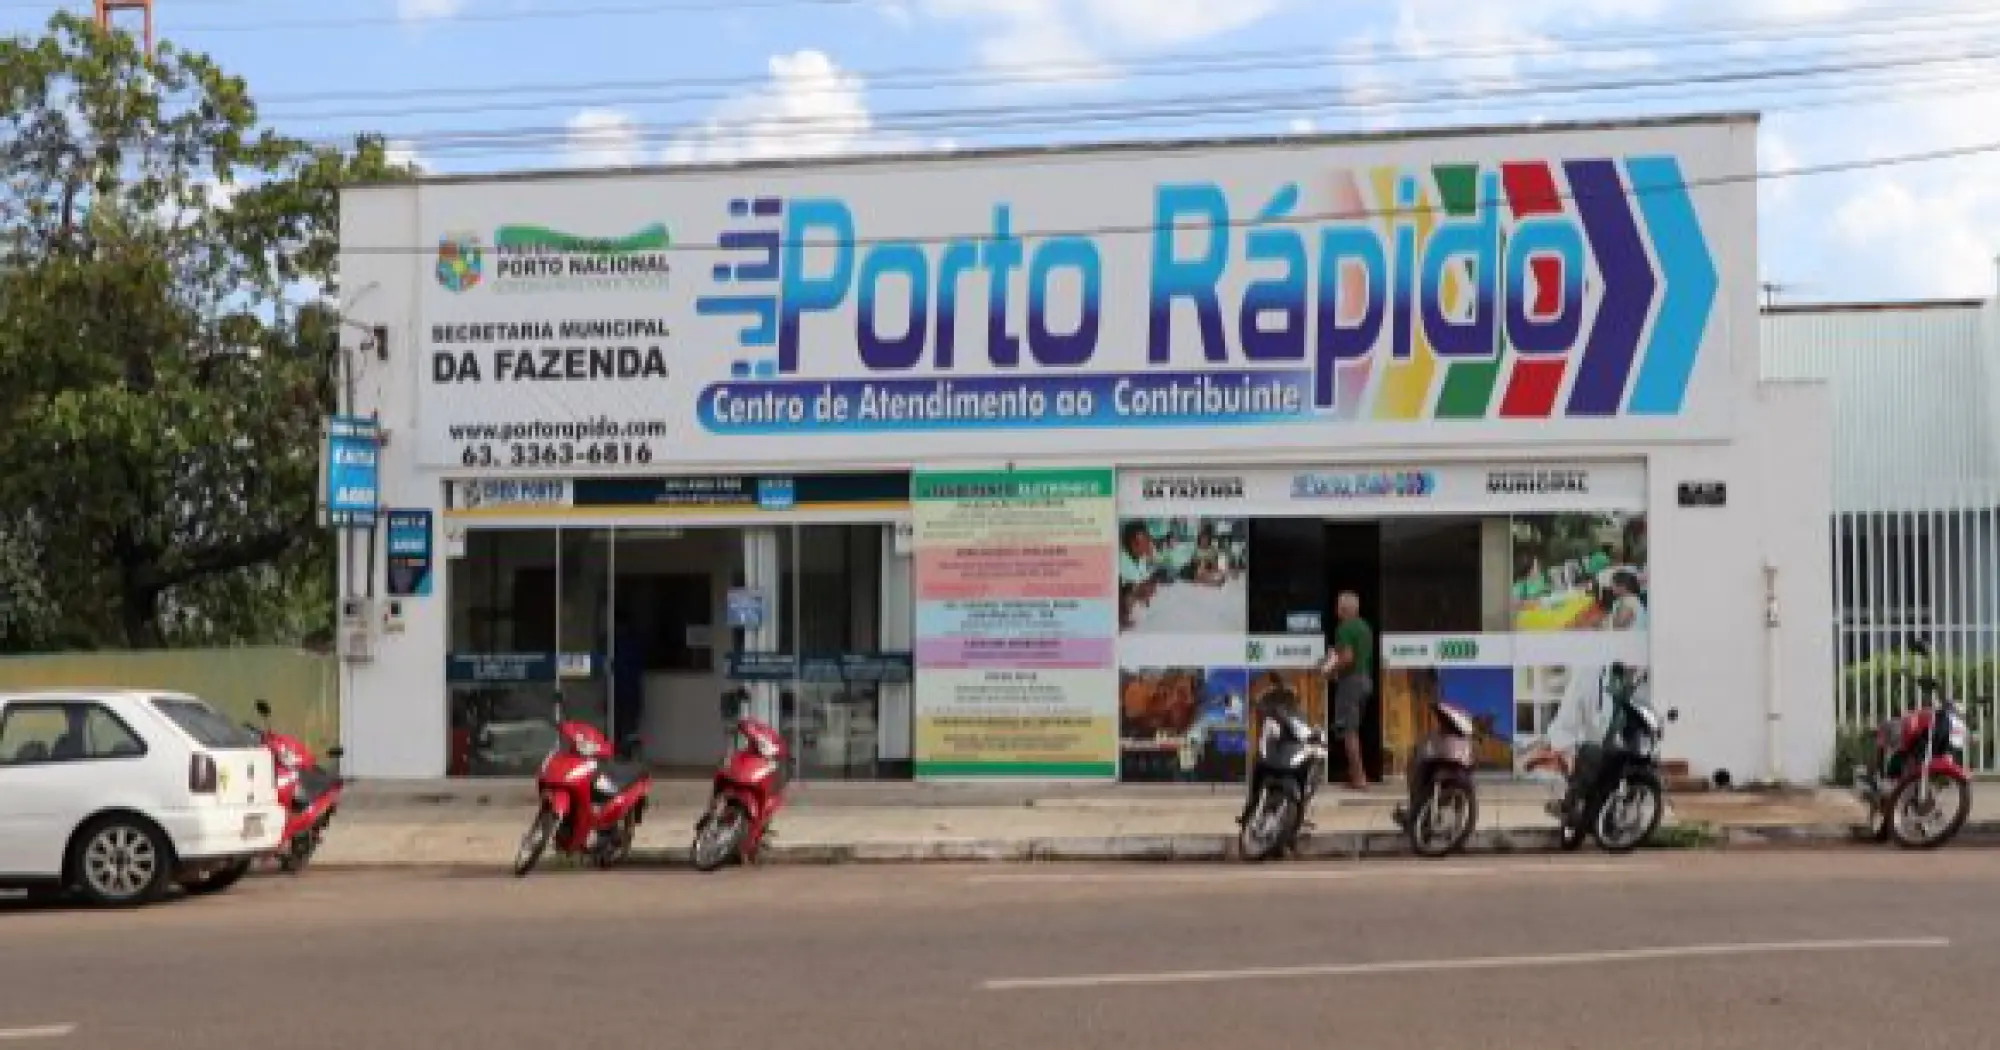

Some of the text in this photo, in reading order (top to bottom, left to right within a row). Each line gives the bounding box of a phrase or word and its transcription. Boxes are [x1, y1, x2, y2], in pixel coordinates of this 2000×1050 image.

[497, 251, 670, 278] PORTO NACIONAL
[779, 173, 1583, 408] Porto Rápido
[432, 319, 669, 343] SECRETARIA MUNICIPAL
[433, 346, 668, 383] DA FAZENDA
[712, 374, 1300, 423] Centro de Atendimento ao Contribuinte
[449, 414, 667, 444] www.portorapido.com
[462, 443, 500, 466] 63.
